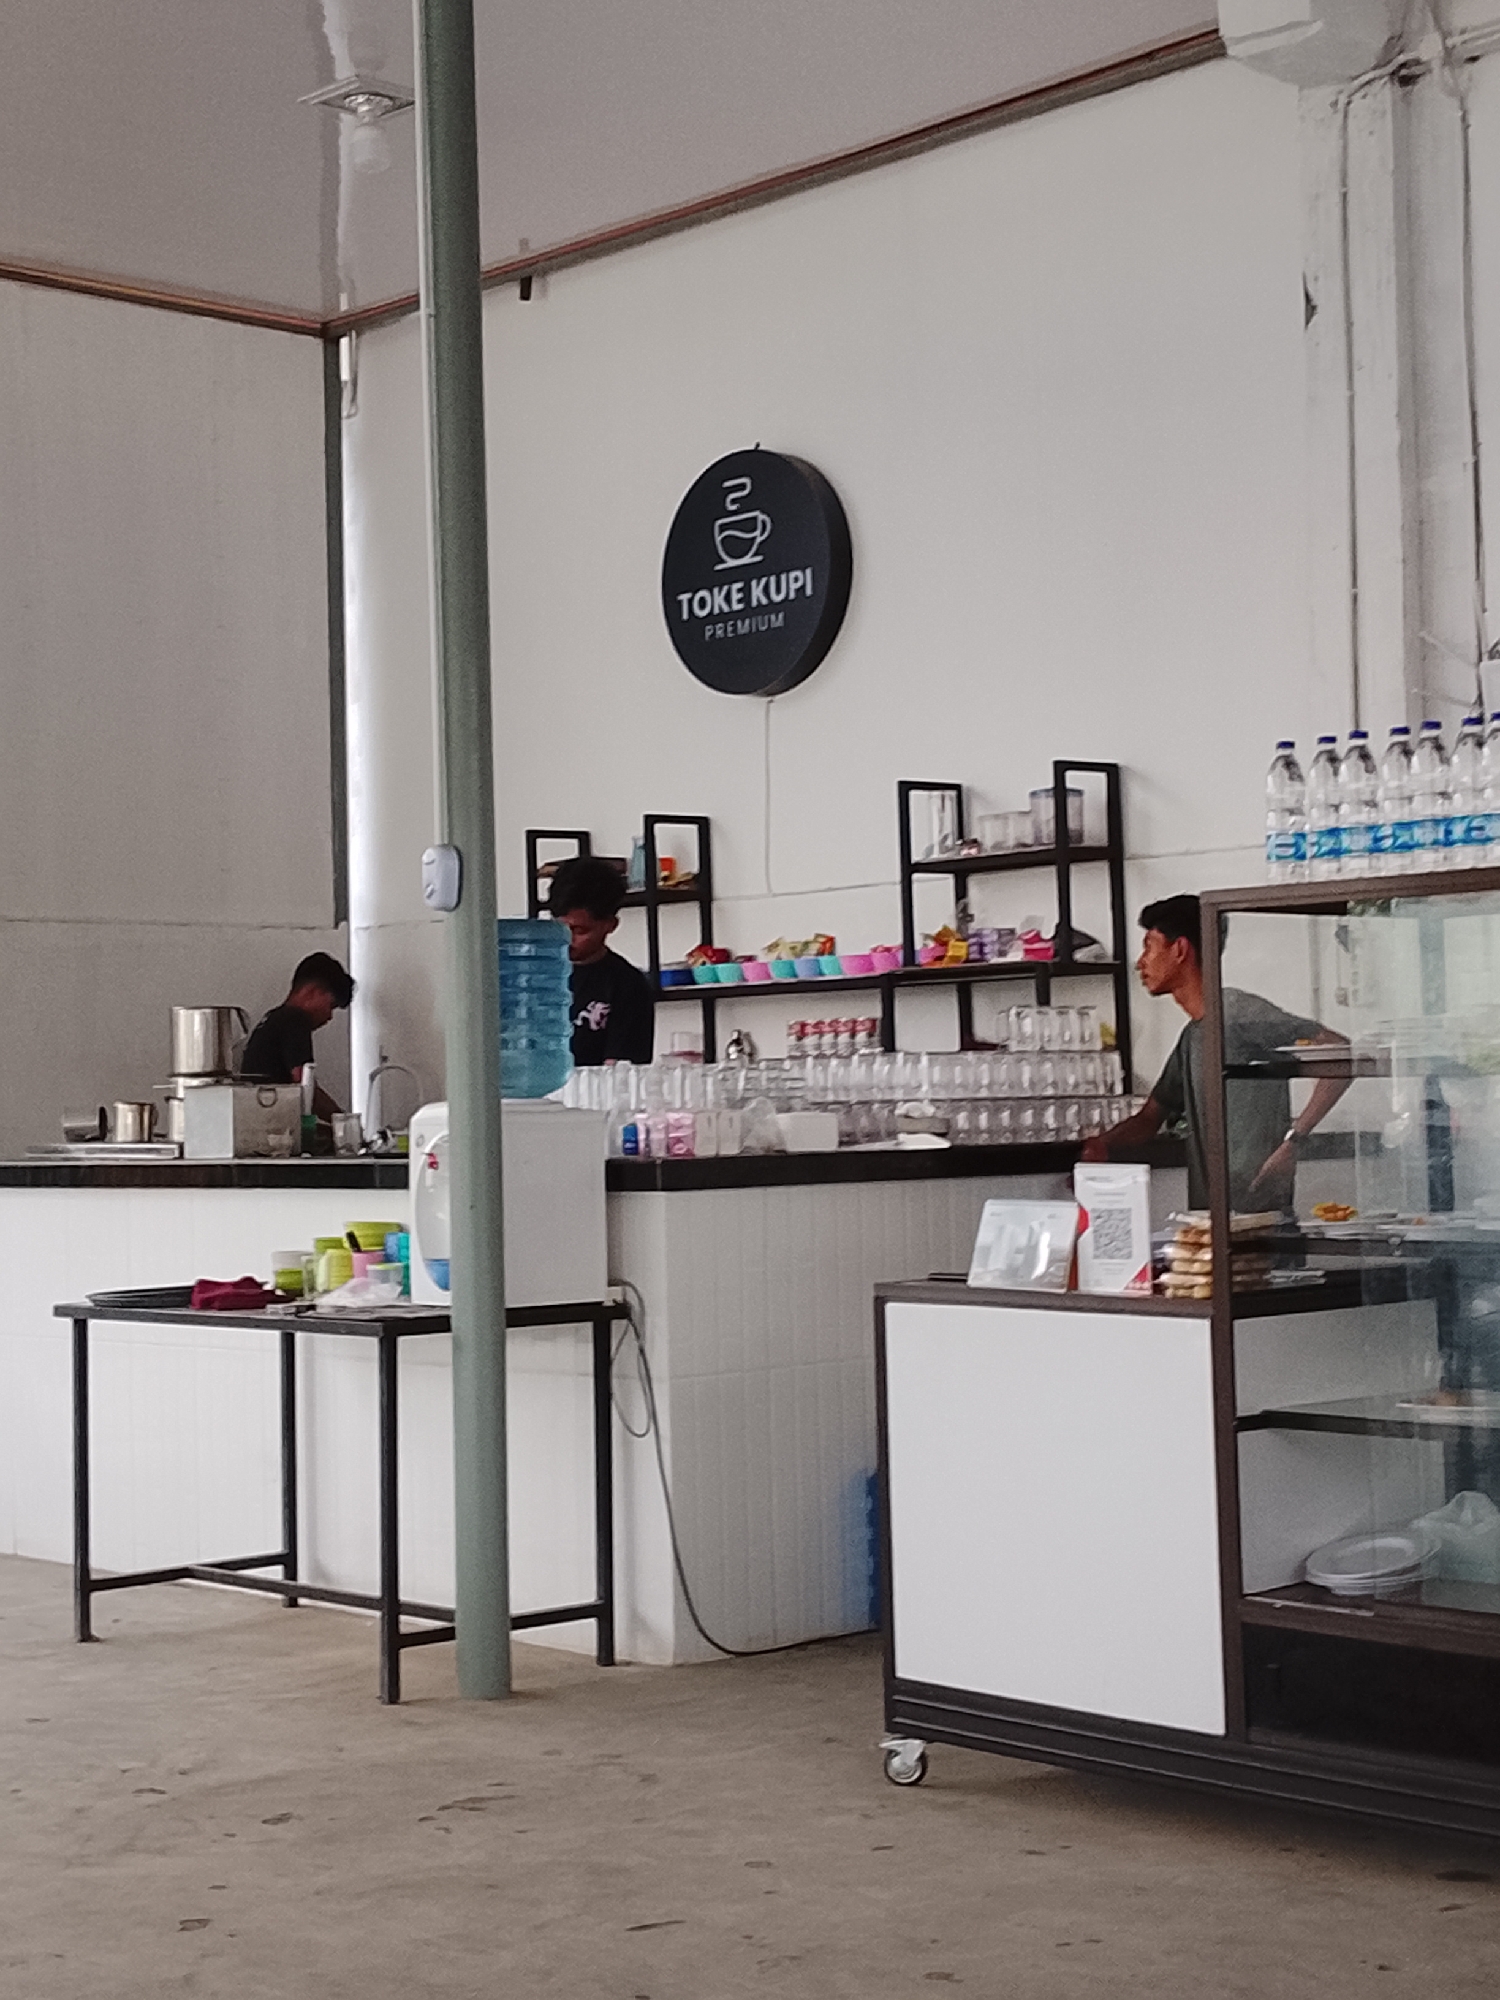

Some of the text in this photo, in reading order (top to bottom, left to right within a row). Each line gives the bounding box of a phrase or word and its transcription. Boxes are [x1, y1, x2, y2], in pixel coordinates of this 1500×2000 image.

[676, 567, 813, 621] TOKE KUPI
[705, 612, 784, 641] PREMIUM
